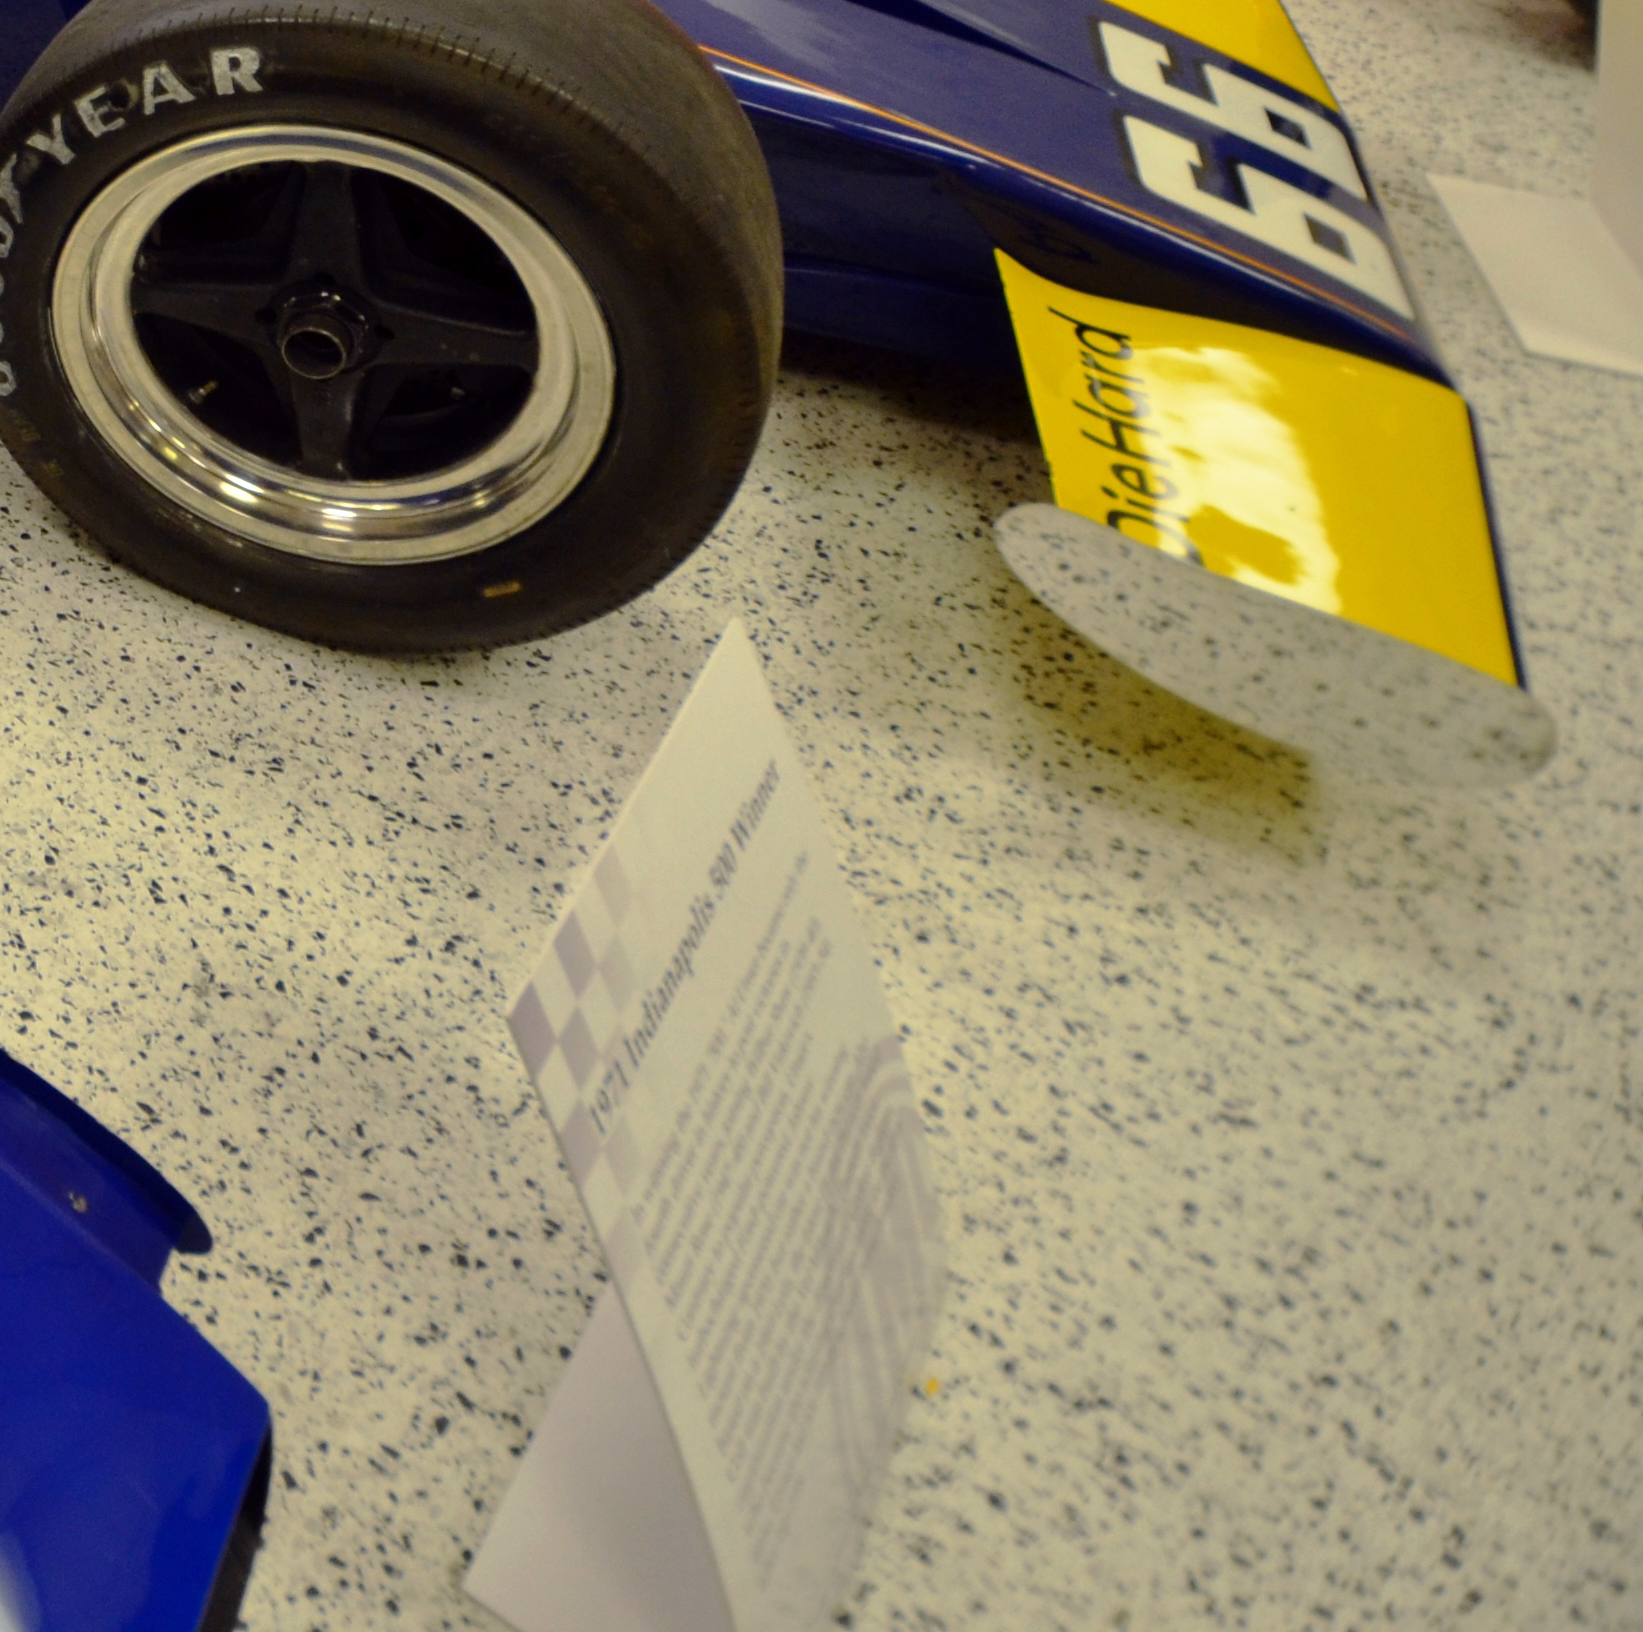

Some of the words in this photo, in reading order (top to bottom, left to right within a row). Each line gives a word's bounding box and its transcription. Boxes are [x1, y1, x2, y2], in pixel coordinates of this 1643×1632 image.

[1097, 20, 1418, 323] 66
[623, 892, 714, 1069] Indianapolis
[708, 841, 738, 901] 500
[728, 760, 781, 852] Winner
